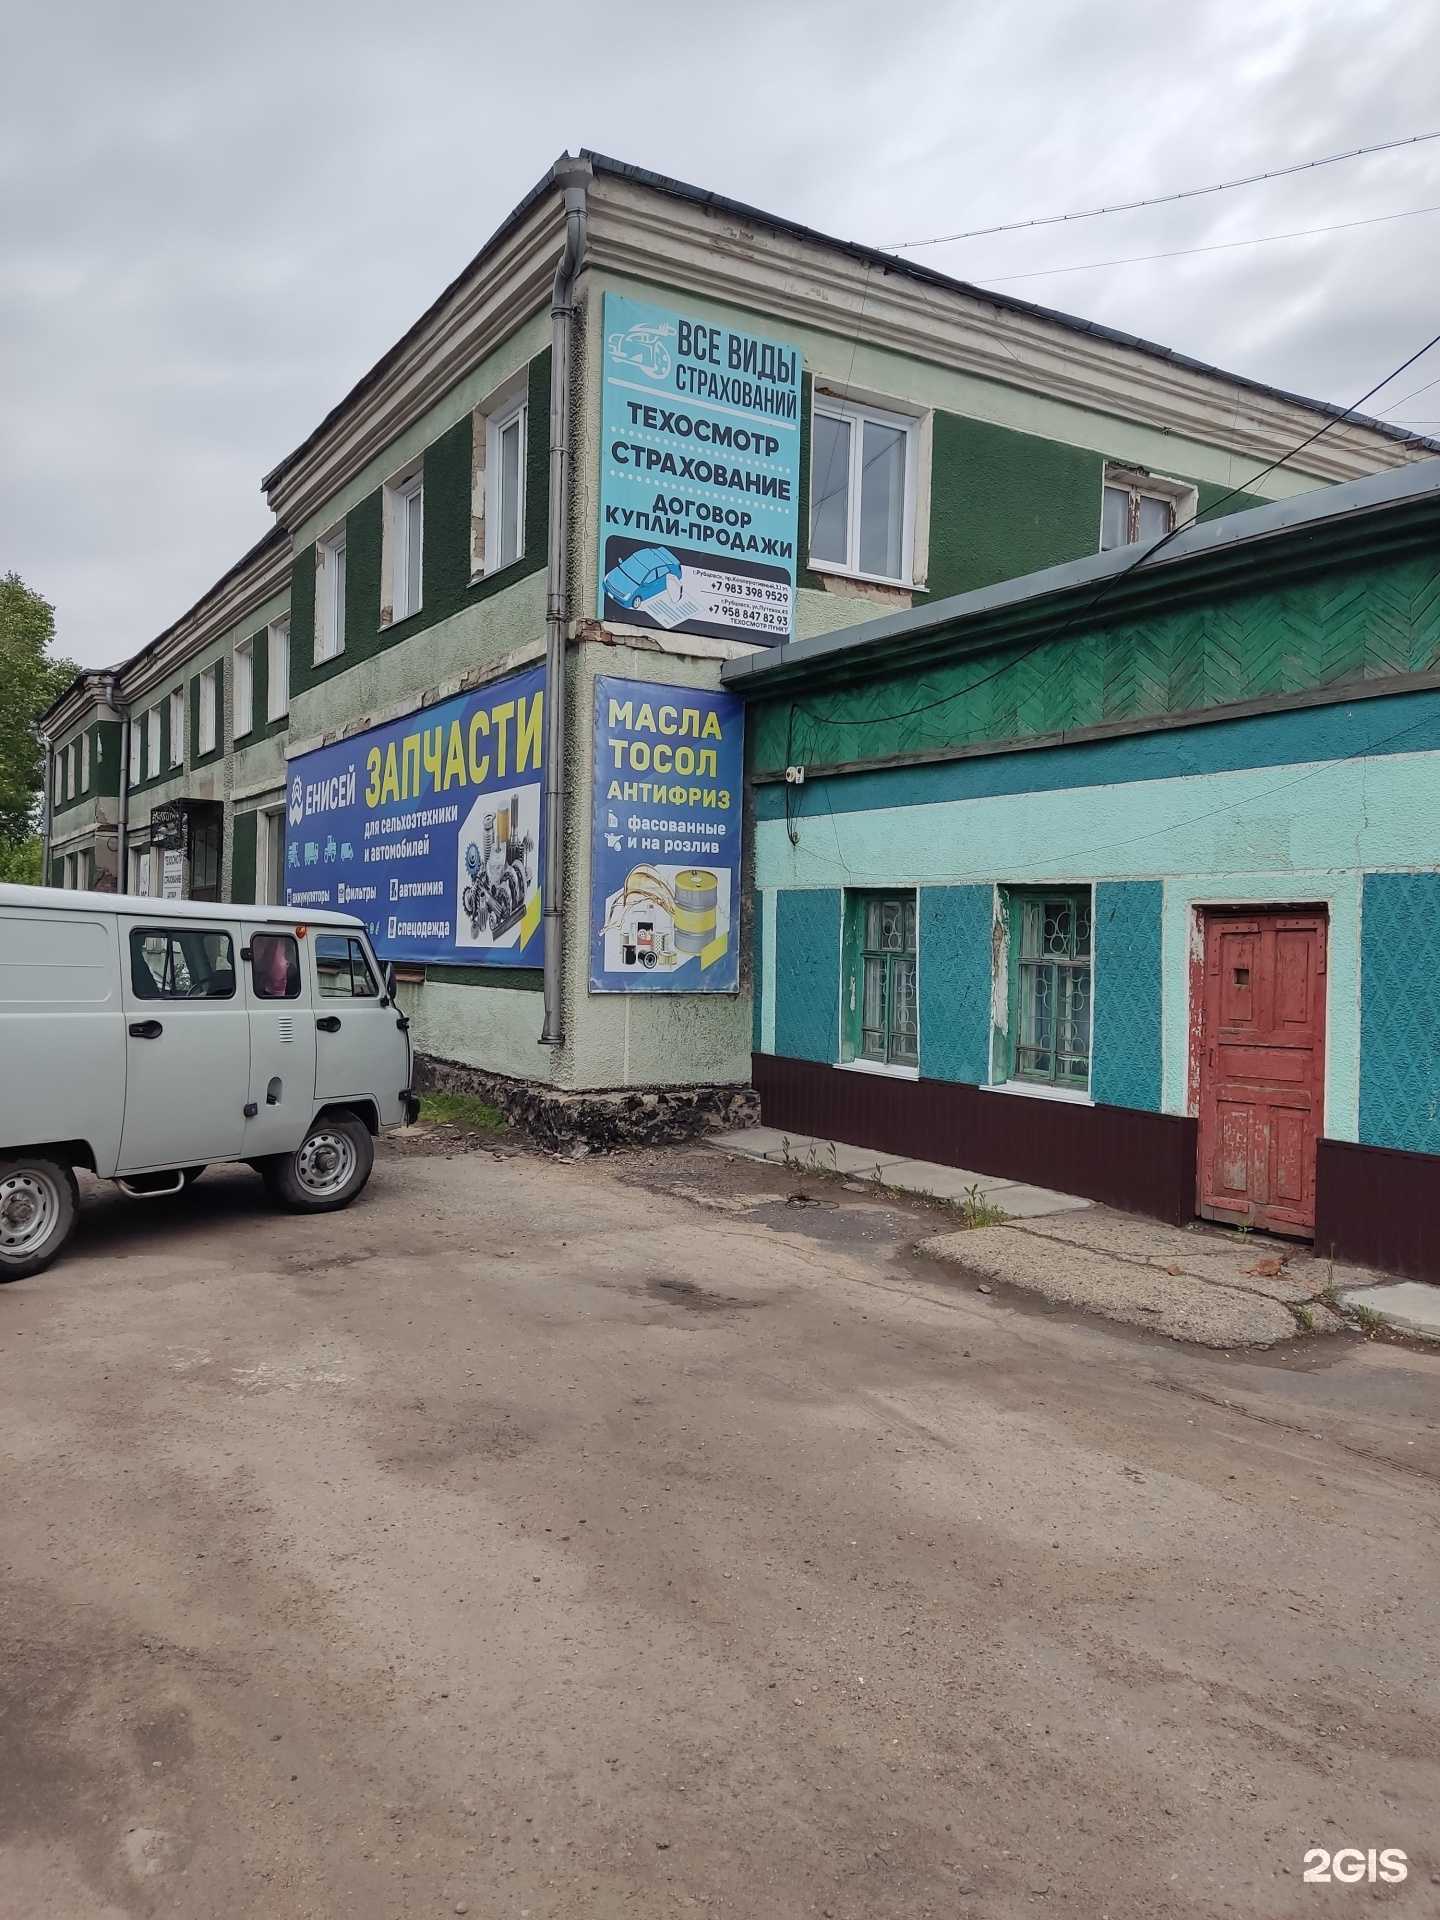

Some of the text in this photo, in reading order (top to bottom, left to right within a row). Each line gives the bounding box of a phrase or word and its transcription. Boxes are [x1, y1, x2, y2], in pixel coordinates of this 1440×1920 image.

[678, 319, 796, 386] ВСЕ ВИДЫ
[676, 363, 797, 419] СТРАХОВАНИЙ
[627, 401, 779, 457] ТЕХОСМОТР
[611, 441, 791, 501] СТРАХОВАНИЕ
[653, 493, 752, 529] ДОГОВОР
[605, 505, 792, 559] КУПЛИ-ПРОДАЖИ
[711, 581, 788, 602] +7 983 398 9529
[709, 604, 788, 626] +7 958 847 82 93
[608, 699, 722, 741] МАСЛА
[365, 691, 544, 809] ЗАПЧАСТИ
[608, 738, 718, 778] ТОСОЛ
[305, 764, 356, 817] ЕНИСЕЙ
[606, 780, 731, 810] АНТИФРИЗ
[364, 804, 459, 841] для сельхозтехники
[627, 814, 726, 836] фасованные
[364, 834, 430, 862] и автомобилей
[627, 836, 720, 855] и на розлив
[345, 884, 377, 903] фильтры
[399, 881, 444, 898] автохимия
[397, 921, 450, 939] спецодежда
